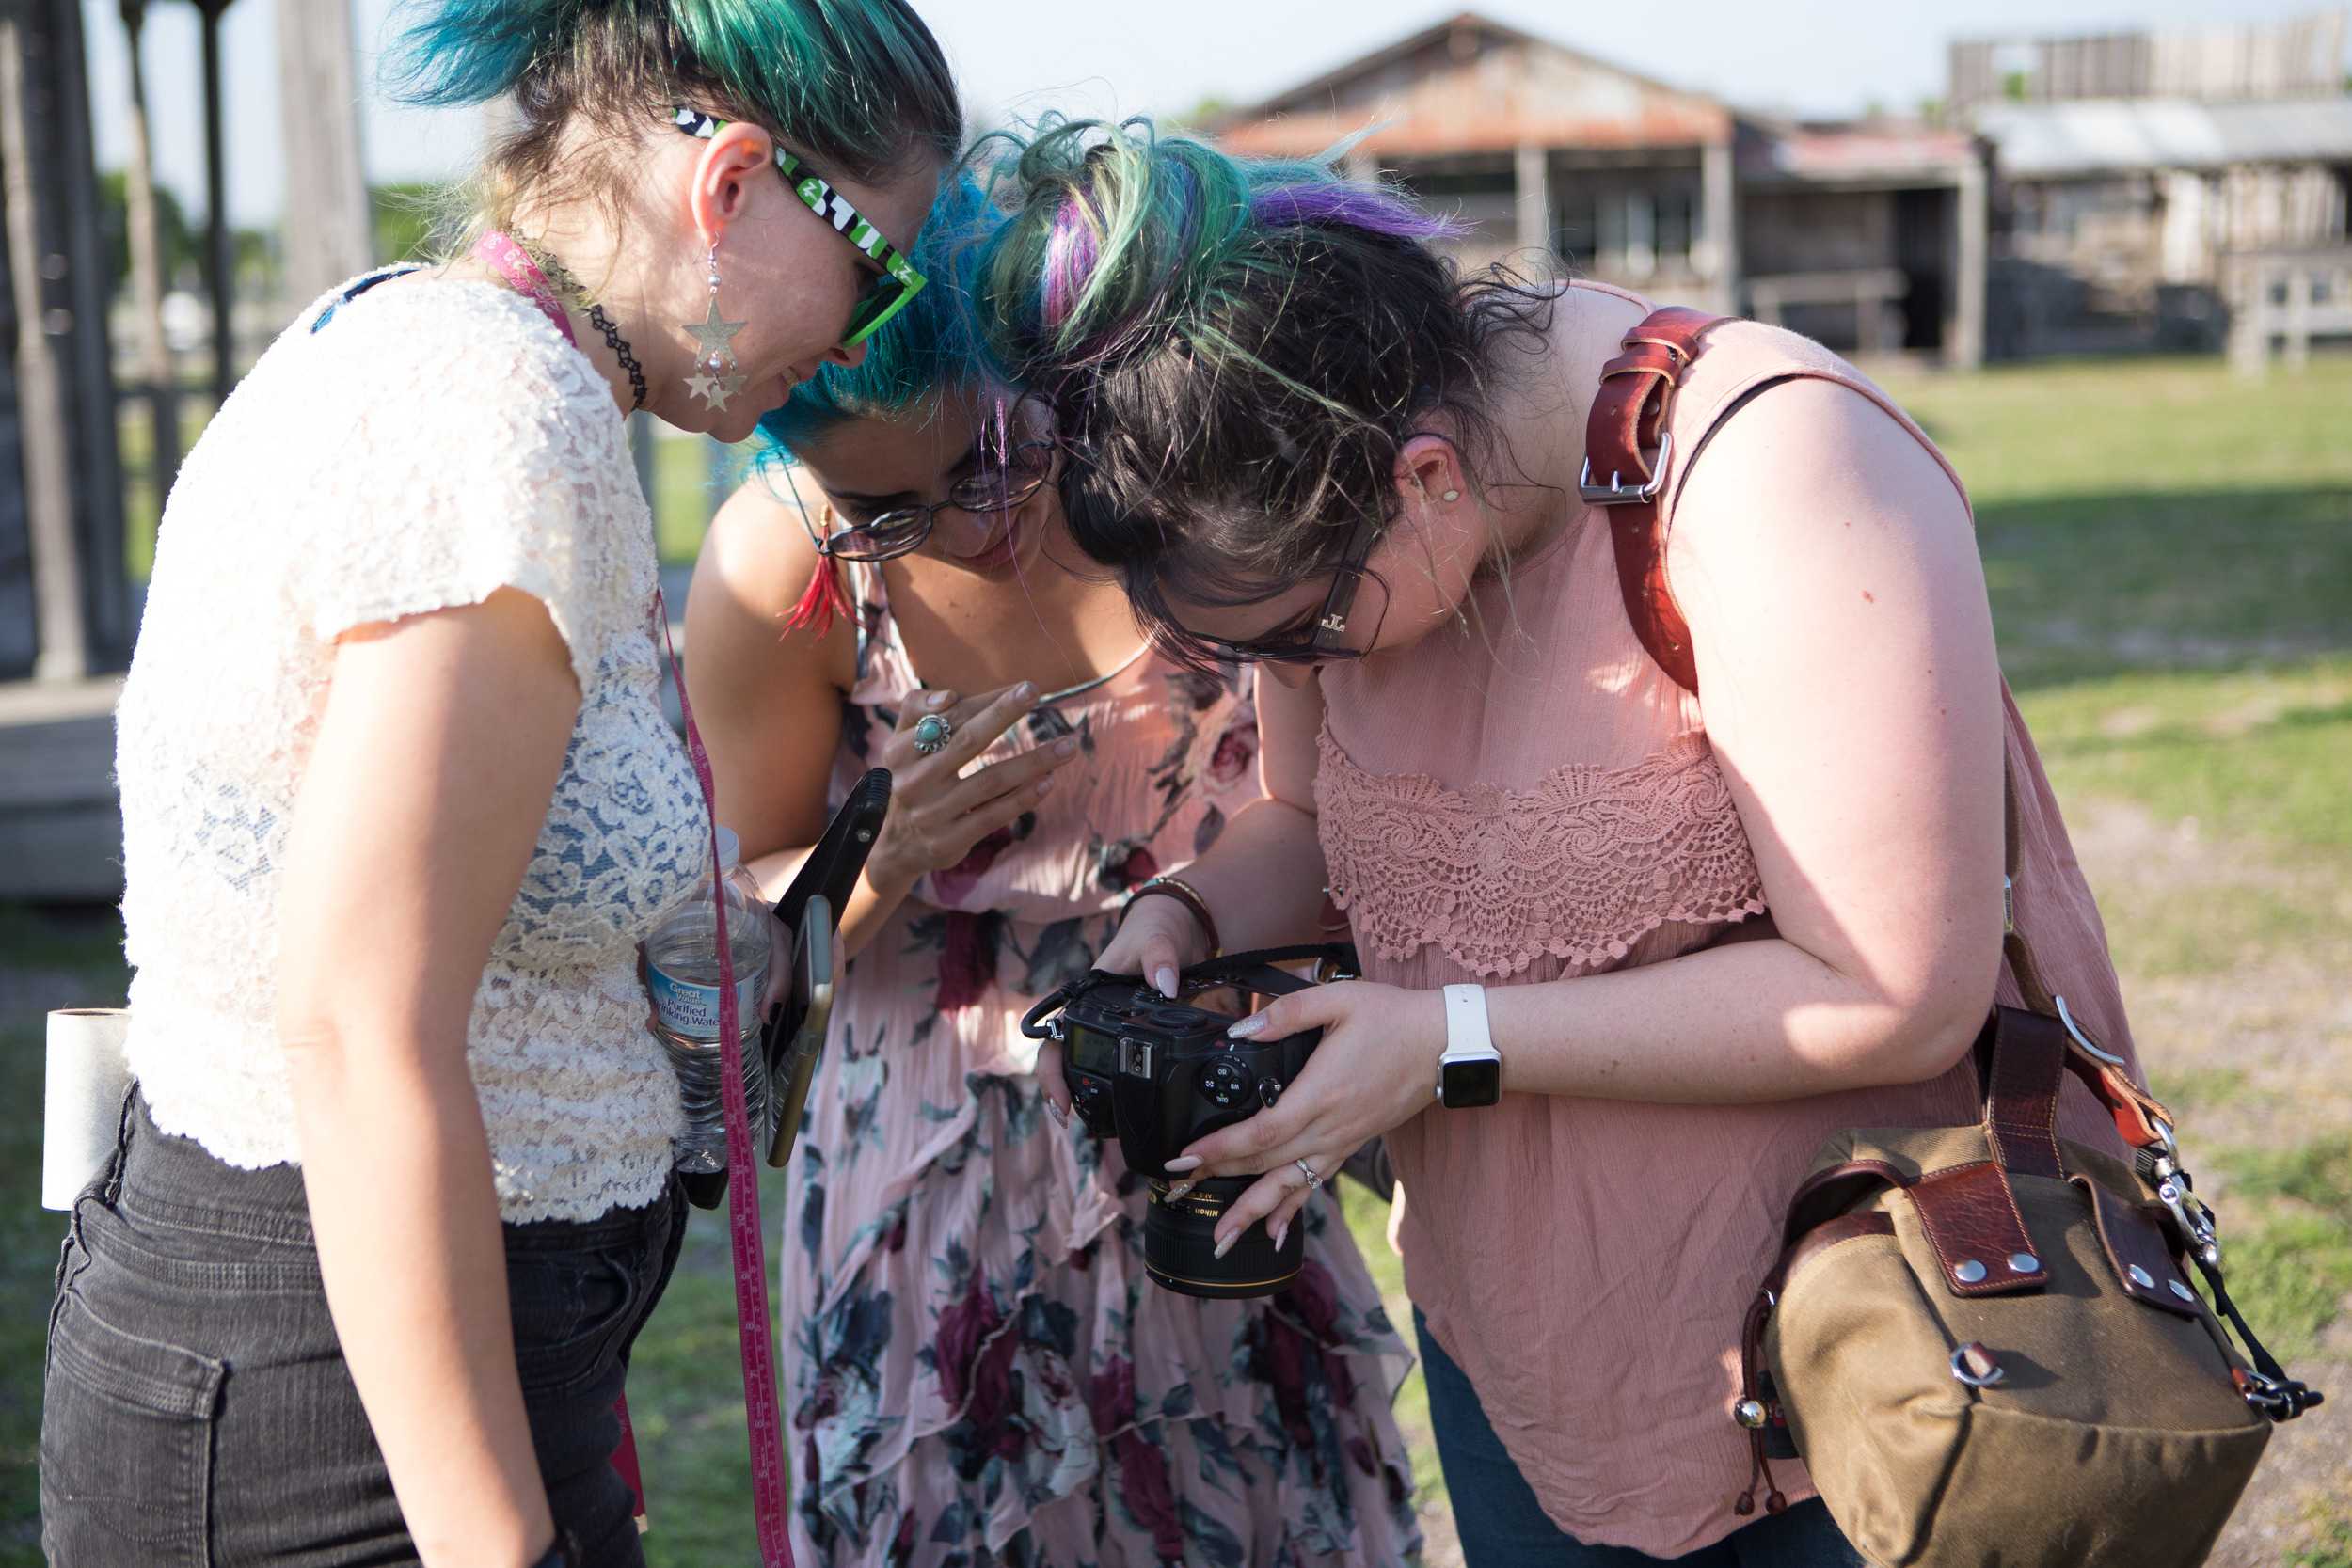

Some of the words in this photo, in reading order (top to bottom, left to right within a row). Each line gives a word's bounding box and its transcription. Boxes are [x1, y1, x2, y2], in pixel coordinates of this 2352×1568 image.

[669, 982, 700, 998] Great
[667, 998, 707, 1017] Purified
[691, 1016, 721, 1026] Wate
[1194, 1208, 1219, 1218] Nikon
